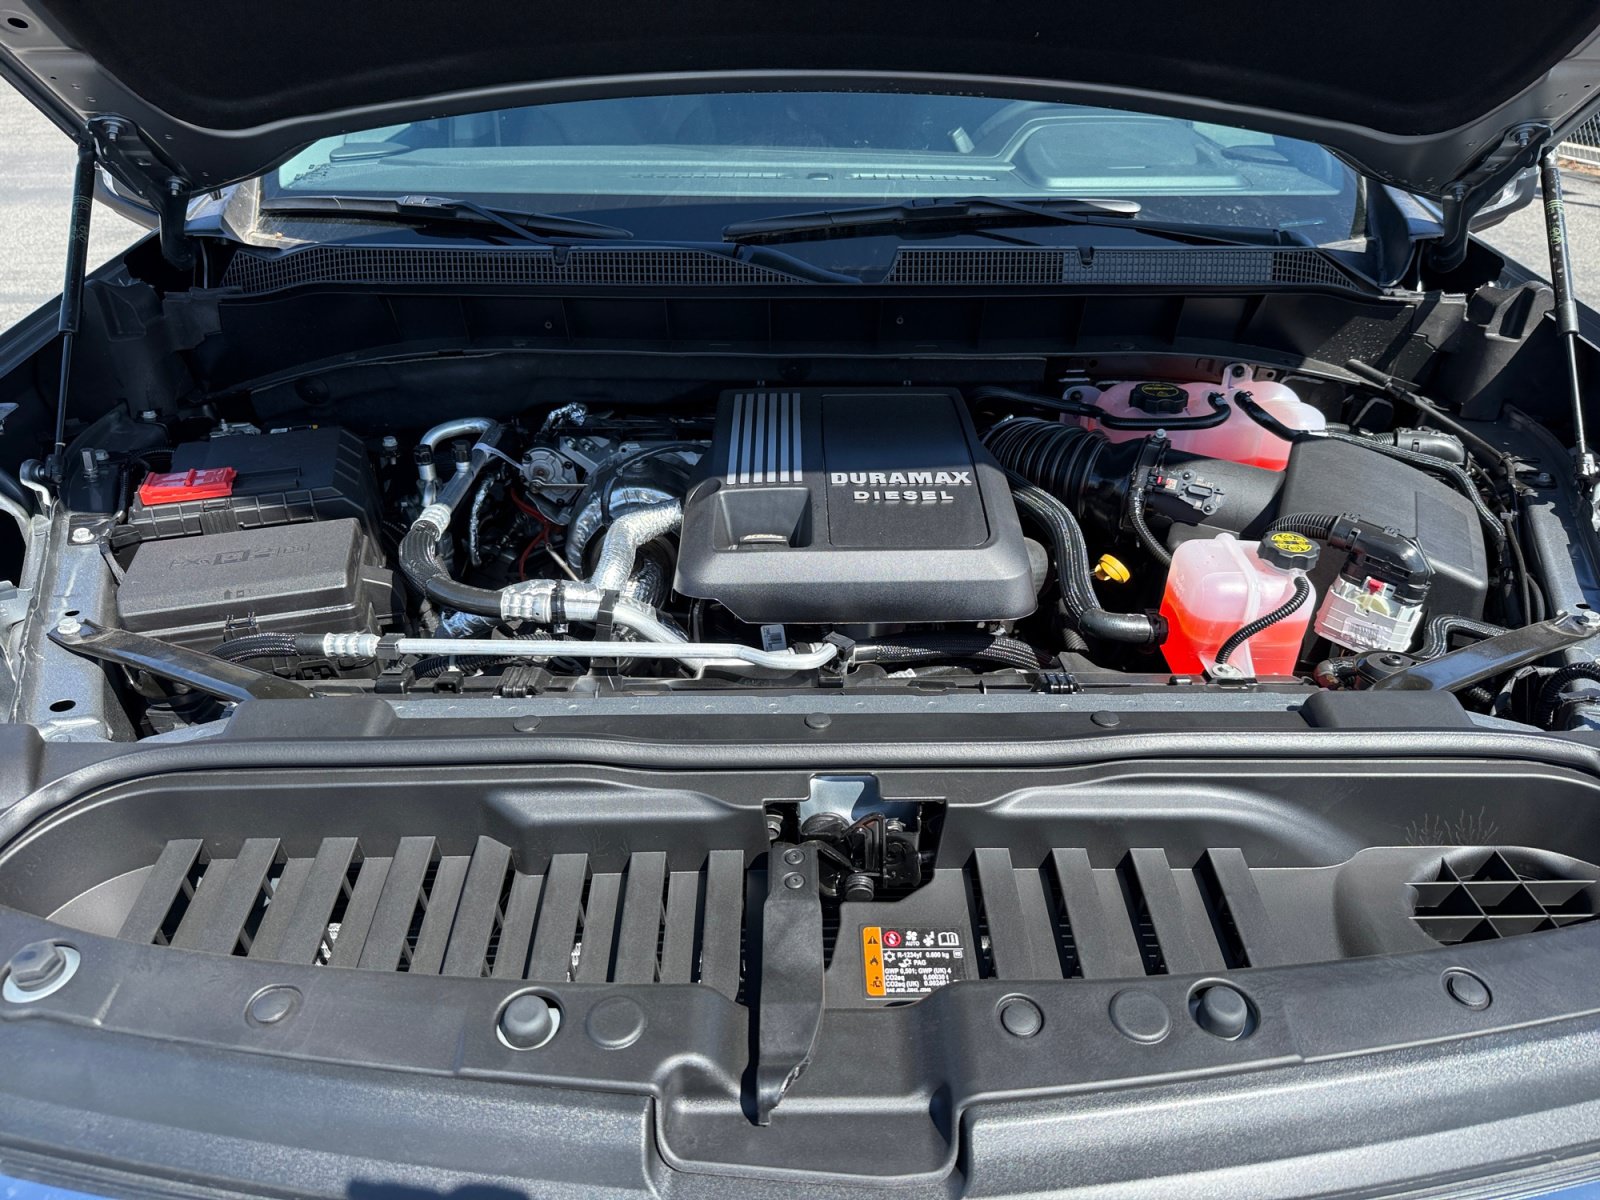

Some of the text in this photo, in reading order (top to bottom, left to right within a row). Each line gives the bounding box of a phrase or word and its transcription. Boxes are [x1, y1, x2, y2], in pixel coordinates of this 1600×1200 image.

[830, 471, 972, 485] DURAMAX
[853, 490, 955, 501] DIESEL
[941, 951, 949, 959] kg
[933, 967, 946, 975] (UK)
